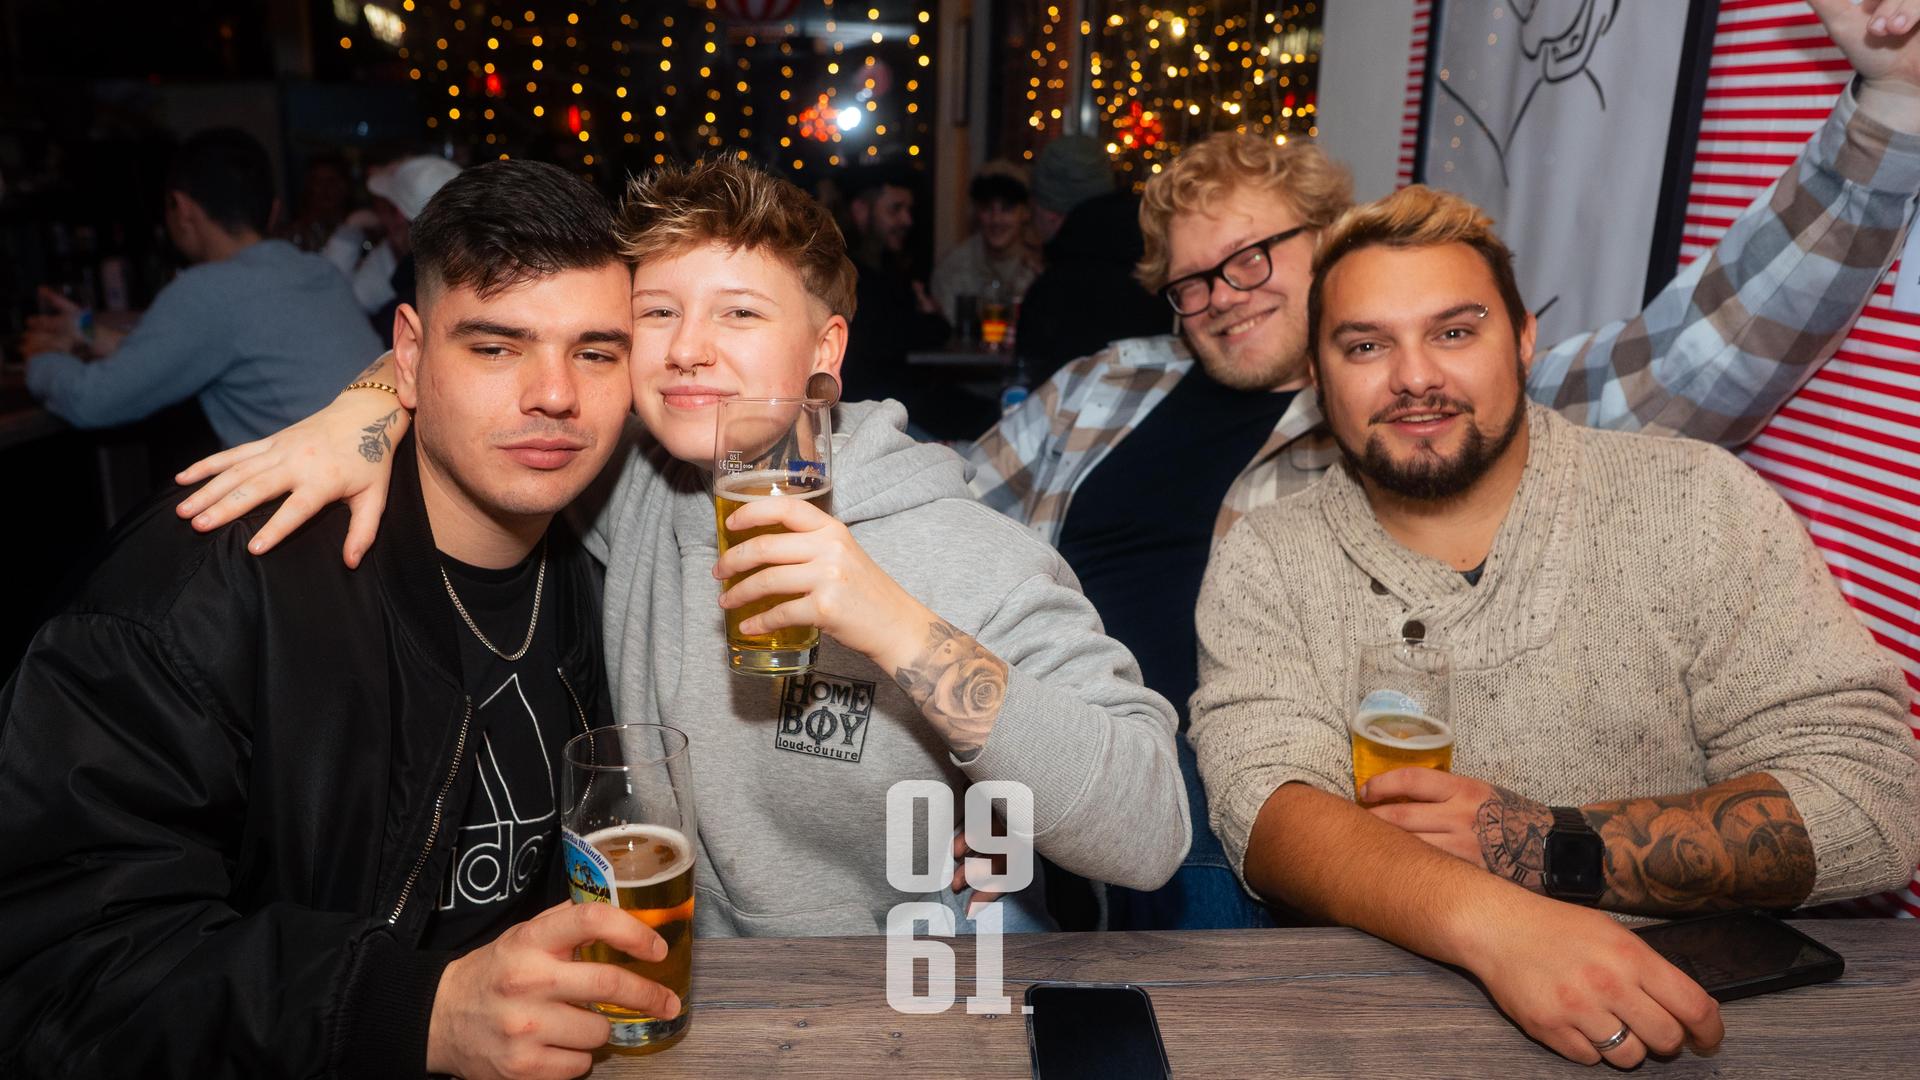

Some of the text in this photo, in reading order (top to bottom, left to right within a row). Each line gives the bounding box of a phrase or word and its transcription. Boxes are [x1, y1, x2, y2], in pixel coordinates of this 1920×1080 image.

[785, 673, 872, 716] HOME
[778, 737, 858, 760] loud-couture
[577, 838, 609, 872] München
